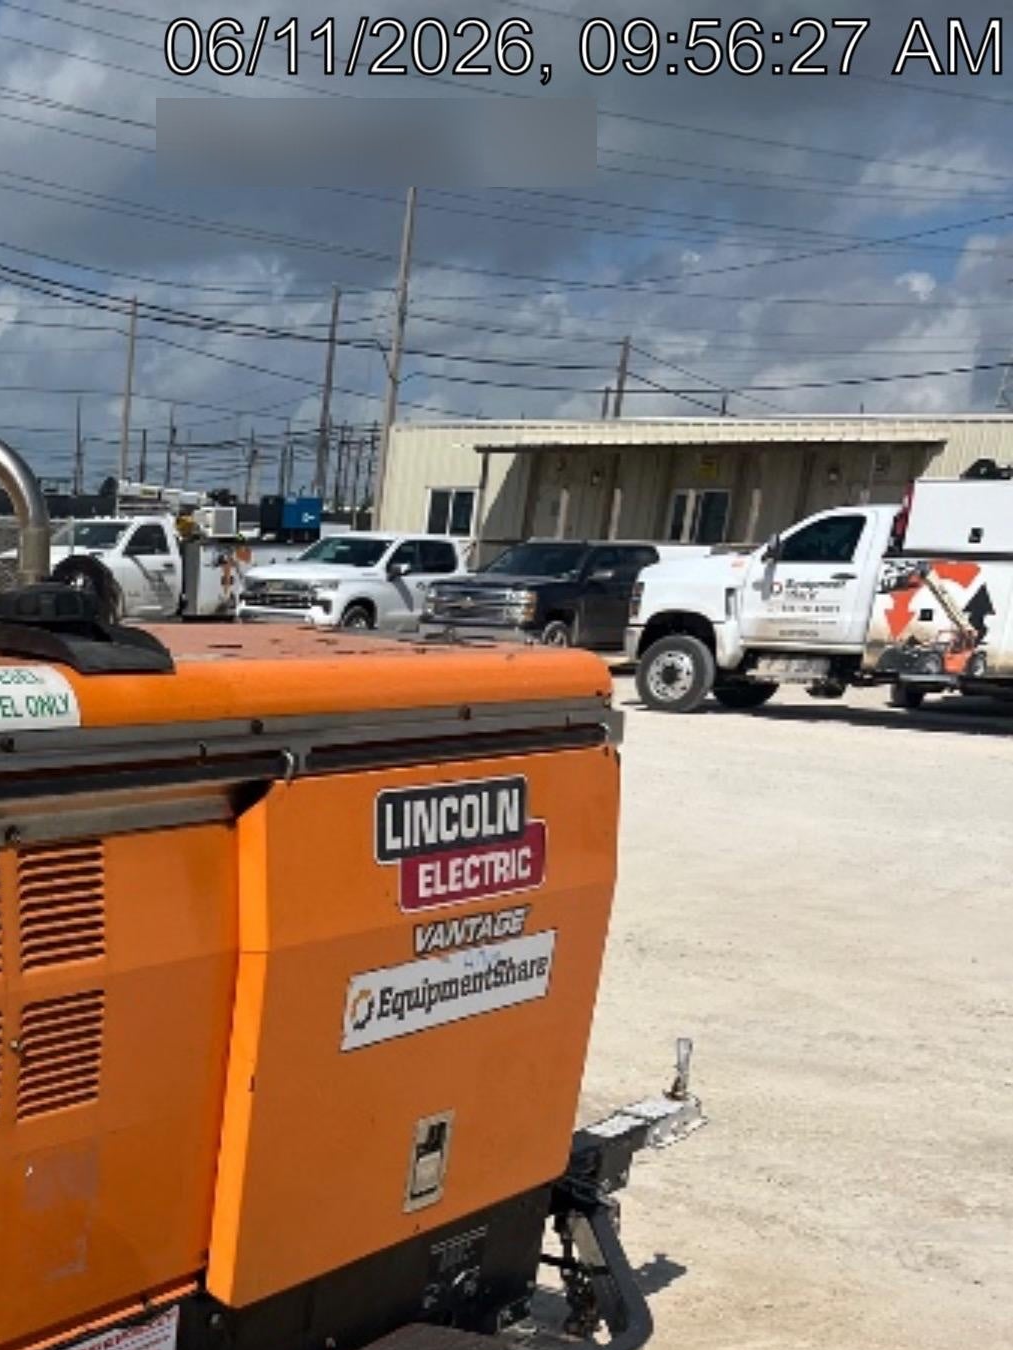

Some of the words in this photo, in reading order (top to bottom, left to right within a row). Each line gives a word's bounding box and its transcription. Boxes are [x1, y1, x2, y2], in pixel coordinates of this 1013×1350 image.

[26, 692, 69, 718] ONLY
[385, 789, 520, 849] LINCOLN
[417, 846, 532, 898] ELECTRIC
[416, 909, 528, 953] VANTAGE
[378, 957, 548, 1019] EquipmentShare
